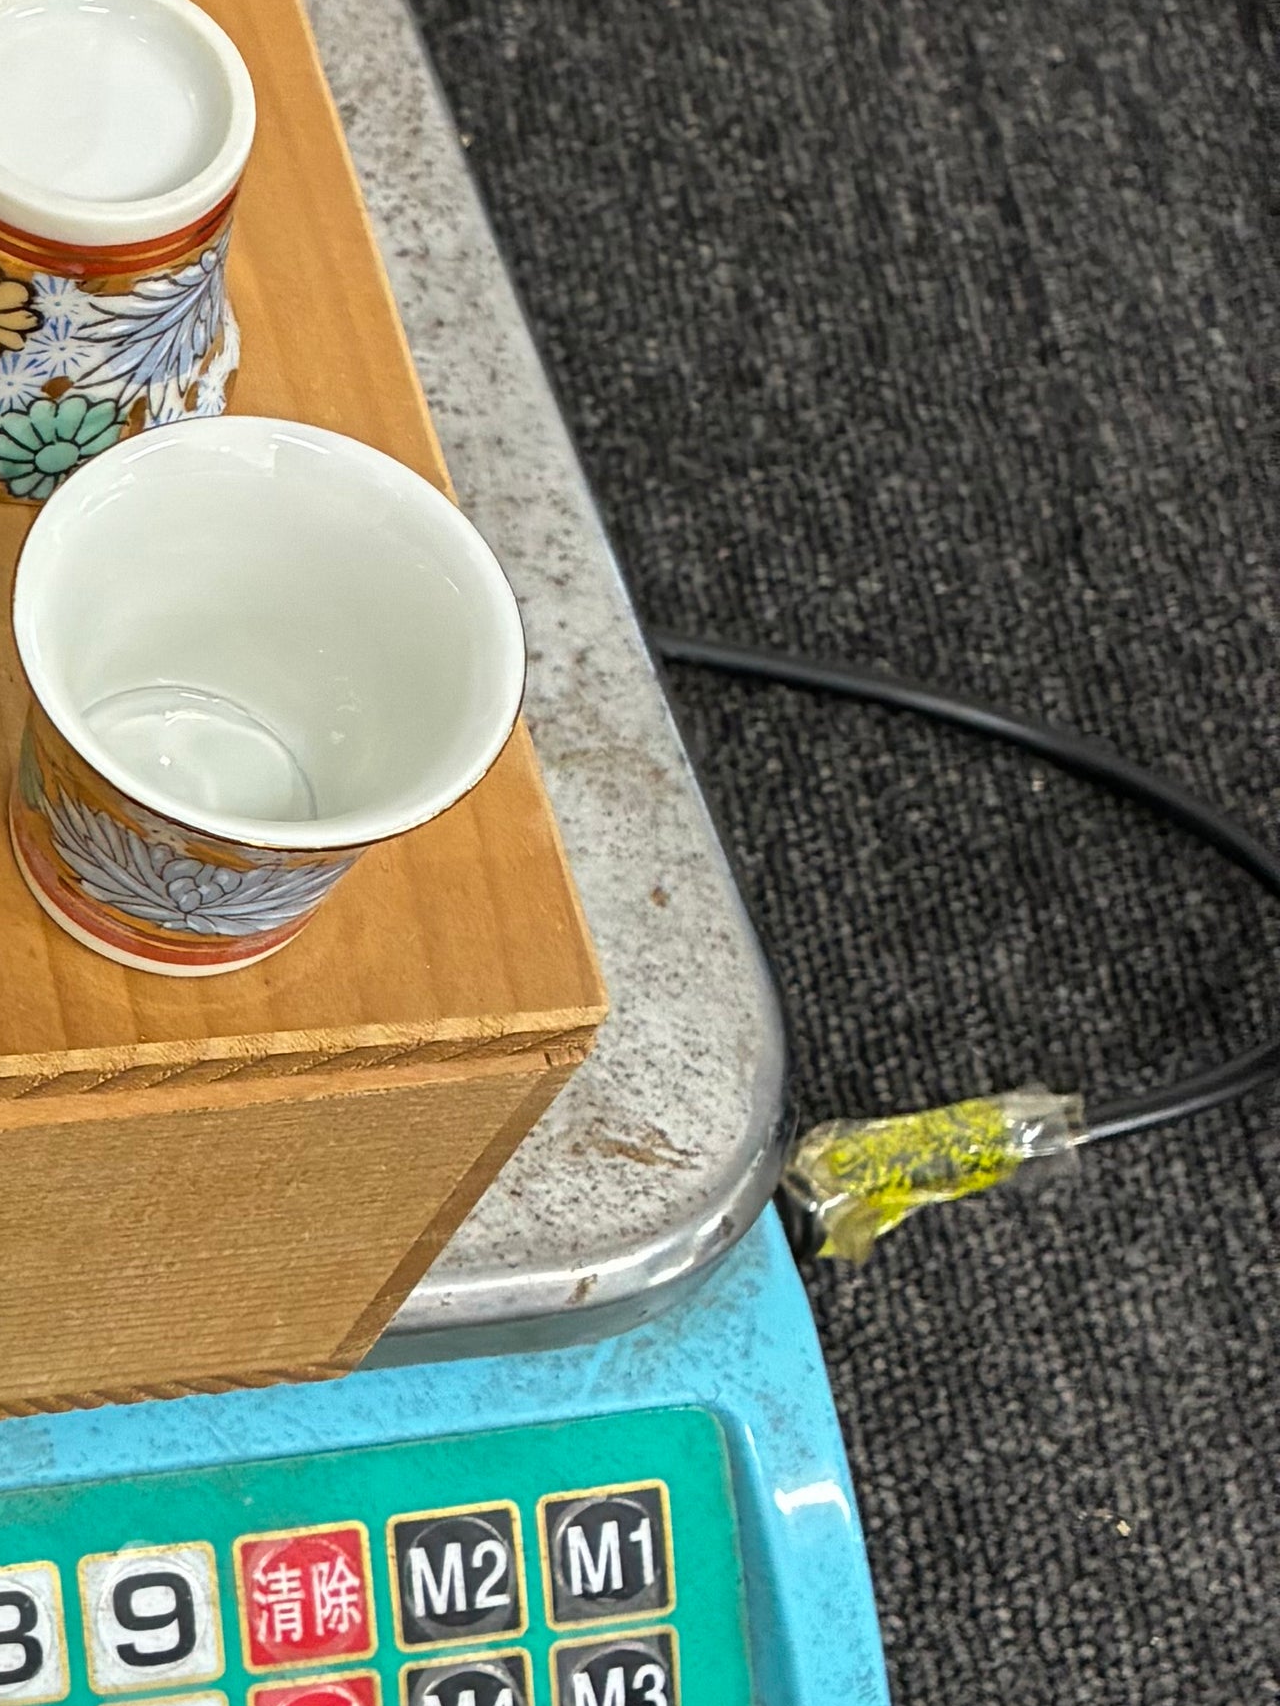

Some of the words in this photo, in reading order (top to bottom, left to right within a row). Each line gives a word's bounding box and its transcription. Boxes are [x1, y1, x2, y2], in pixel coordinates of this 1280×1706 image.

[112, 1571, 197, 1667] 9
[253, 1556, 363, 1644] 清除
[408, 1539, 511, 1617] M2
[566, 1517, 655, 1596] M1
